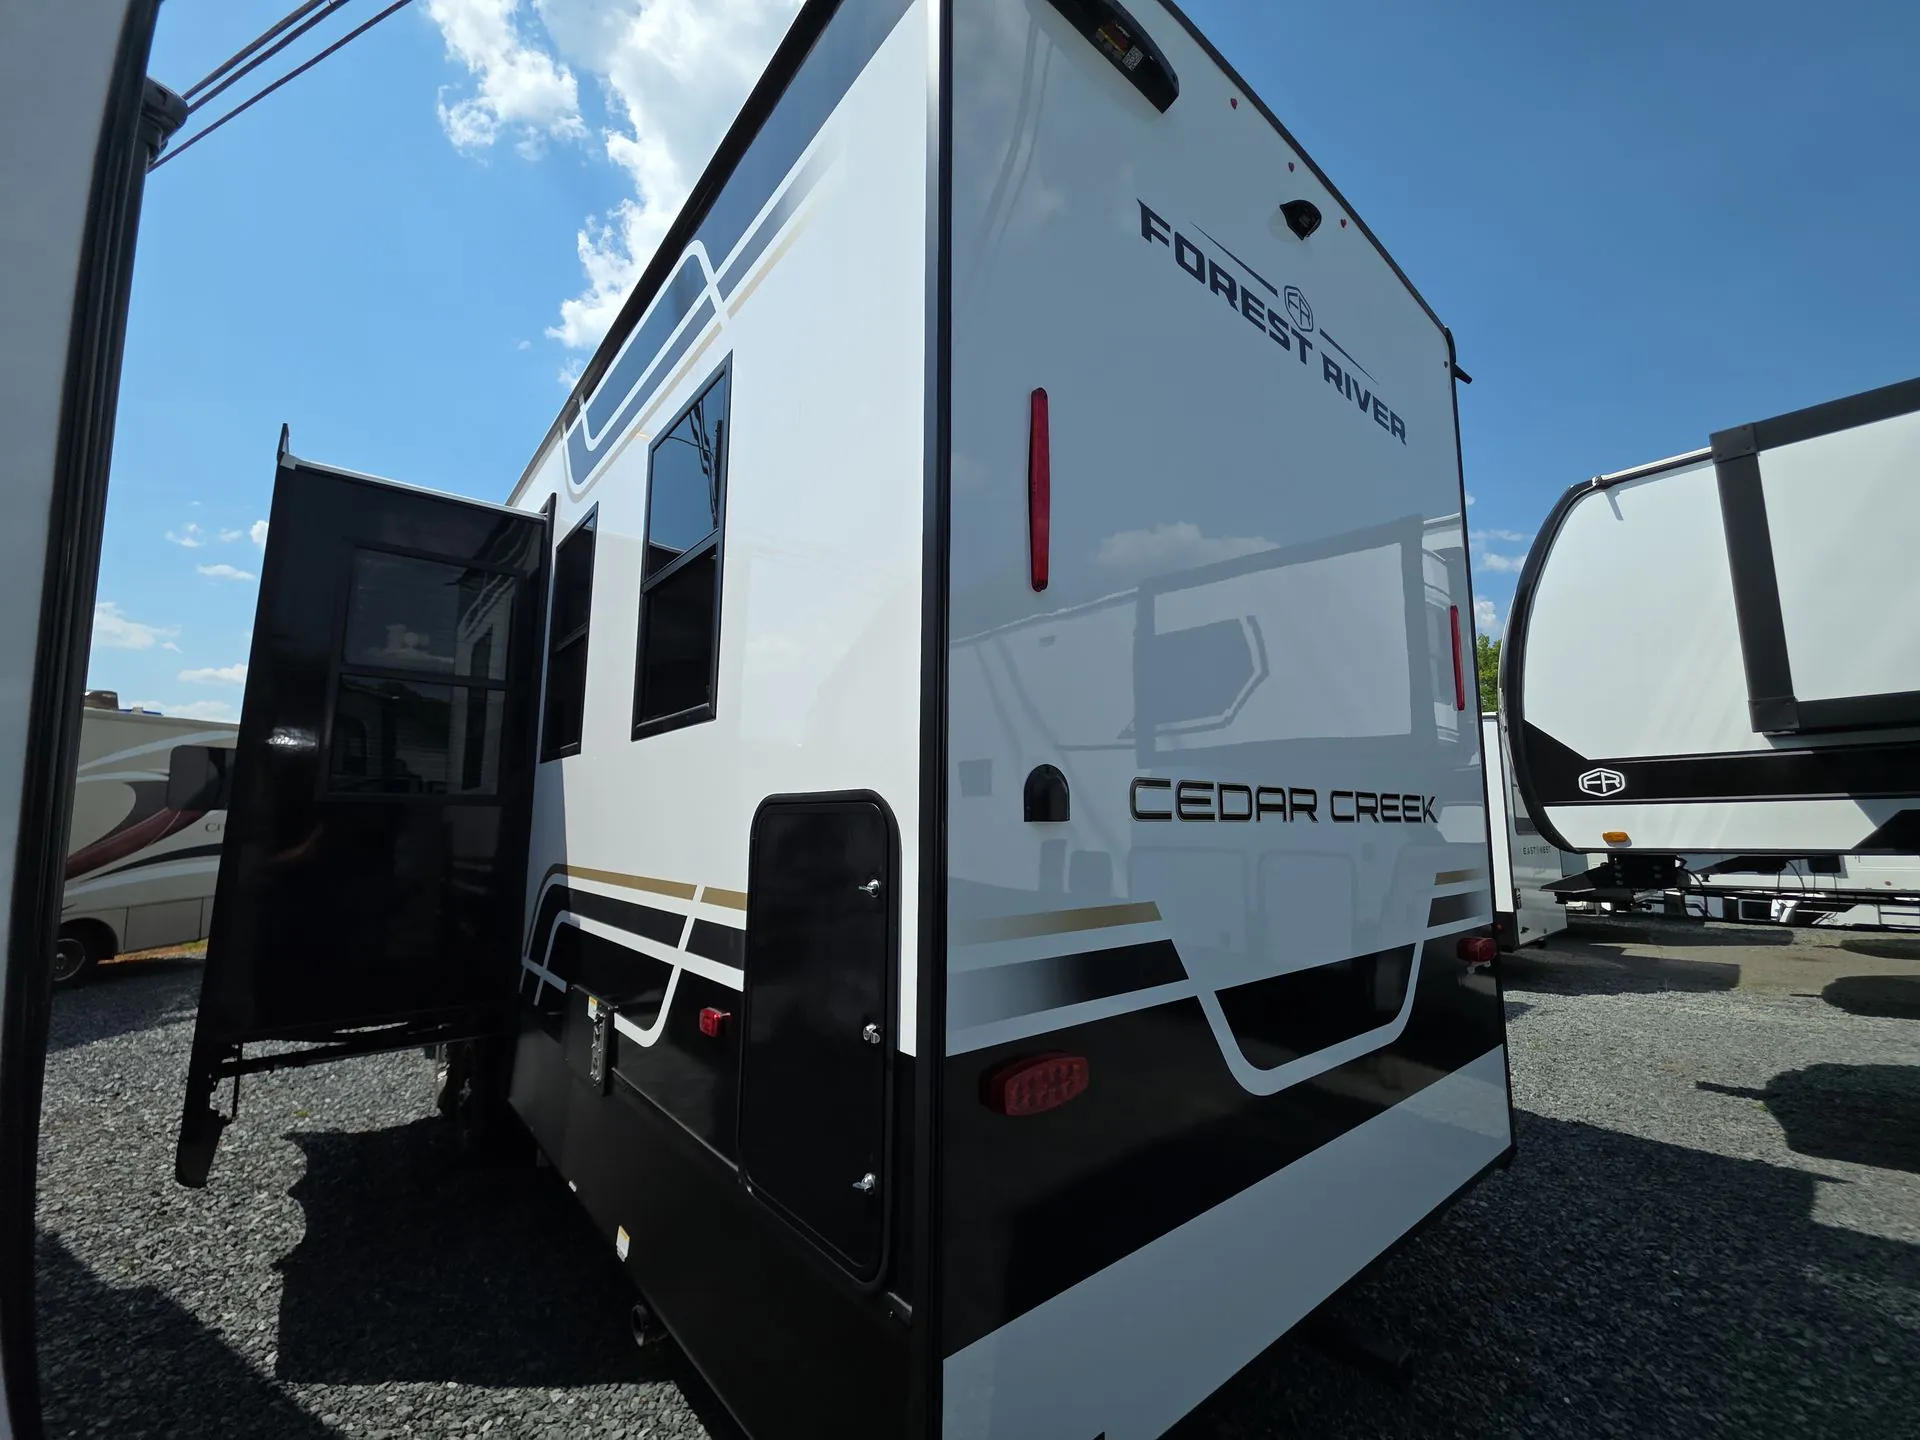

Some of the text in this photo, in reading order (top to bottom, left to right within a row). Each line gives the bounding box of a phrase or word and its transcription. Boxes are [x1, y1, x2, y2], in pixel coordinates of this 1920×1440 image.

[1137, 198, 1406, 446] FOREST RIVER
[1129, 777, 1438, 823] CEDAR CREEK
